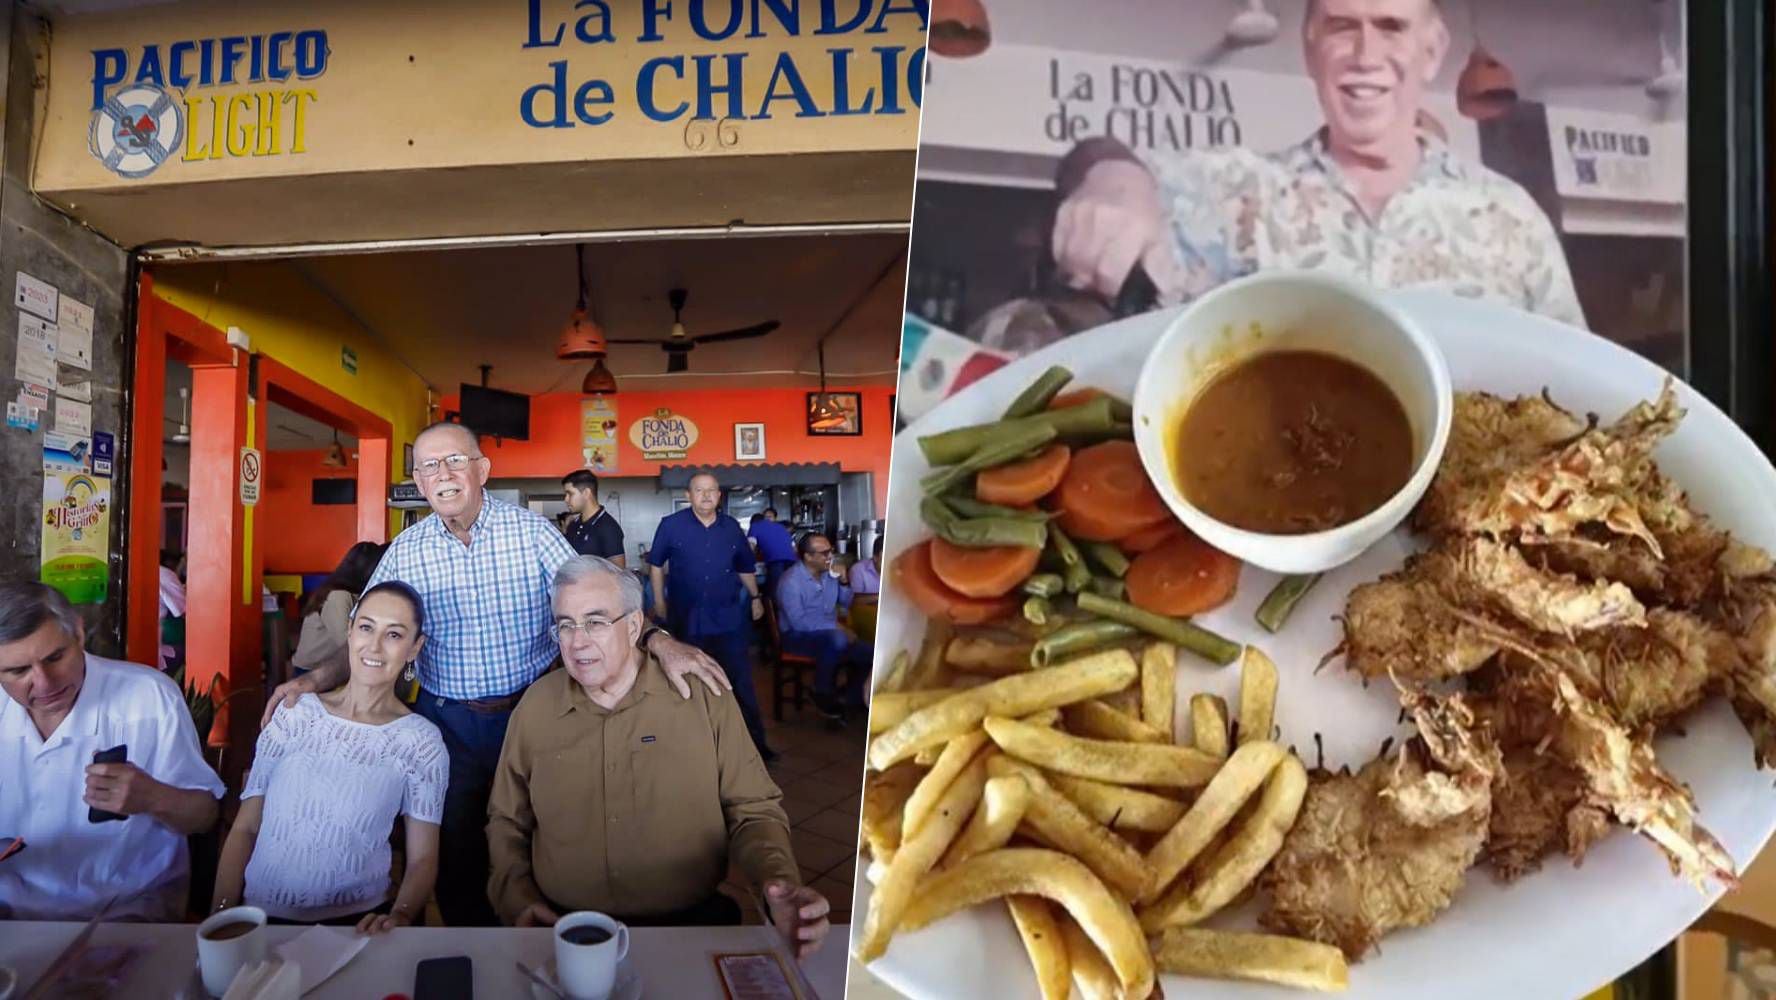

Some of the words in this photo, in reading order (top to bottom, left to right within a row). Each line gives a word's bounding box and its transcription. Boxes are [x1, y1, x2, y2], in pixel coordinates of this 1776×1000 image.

[522, 0, 616, 49] La
[90, 29, 332, 110] PACIFICO
[520, 60, 615, 128] de
[1050, 59, 1093, 102] La
[1111, 65, 1235, 114] FONDA
[181, 88, 317, 162] LIGHT
[642, 433, 688, 449] CHALIO
[643, 419, 686, 434] FONDA
